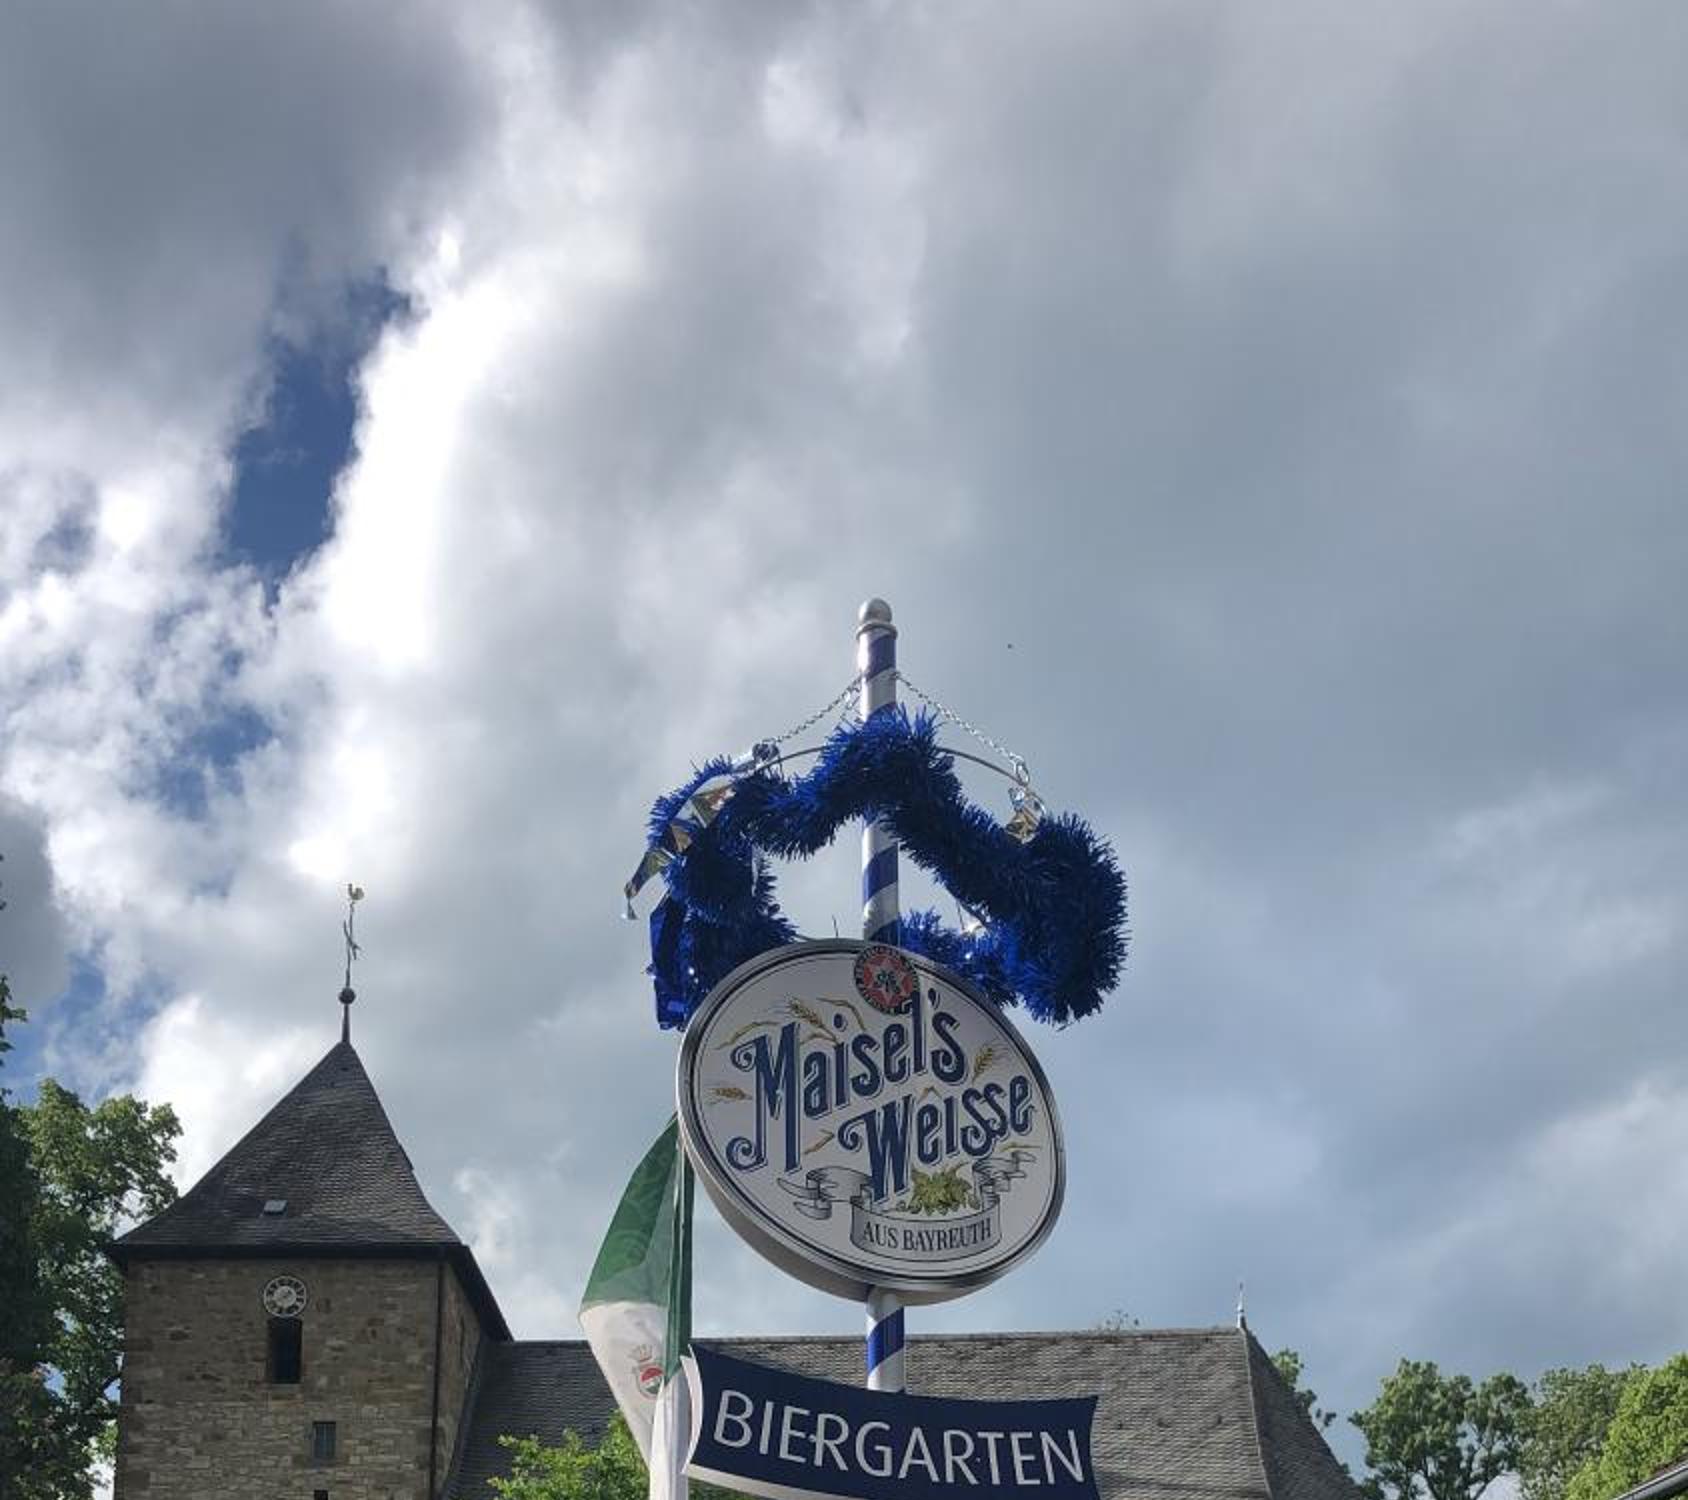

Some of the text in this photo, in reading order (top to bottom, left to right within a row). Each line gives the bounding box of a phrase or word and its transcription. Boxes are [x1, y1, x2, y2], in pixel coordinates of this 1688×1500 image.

[725, 989, 968, 1174] Maisel's
[838, 1074, 1036, 1206] Weisse
[863, 1218, 993, 1251] AUS BAYREUTH
[713, 1389, 1085, 1486] BIERGARTEN
